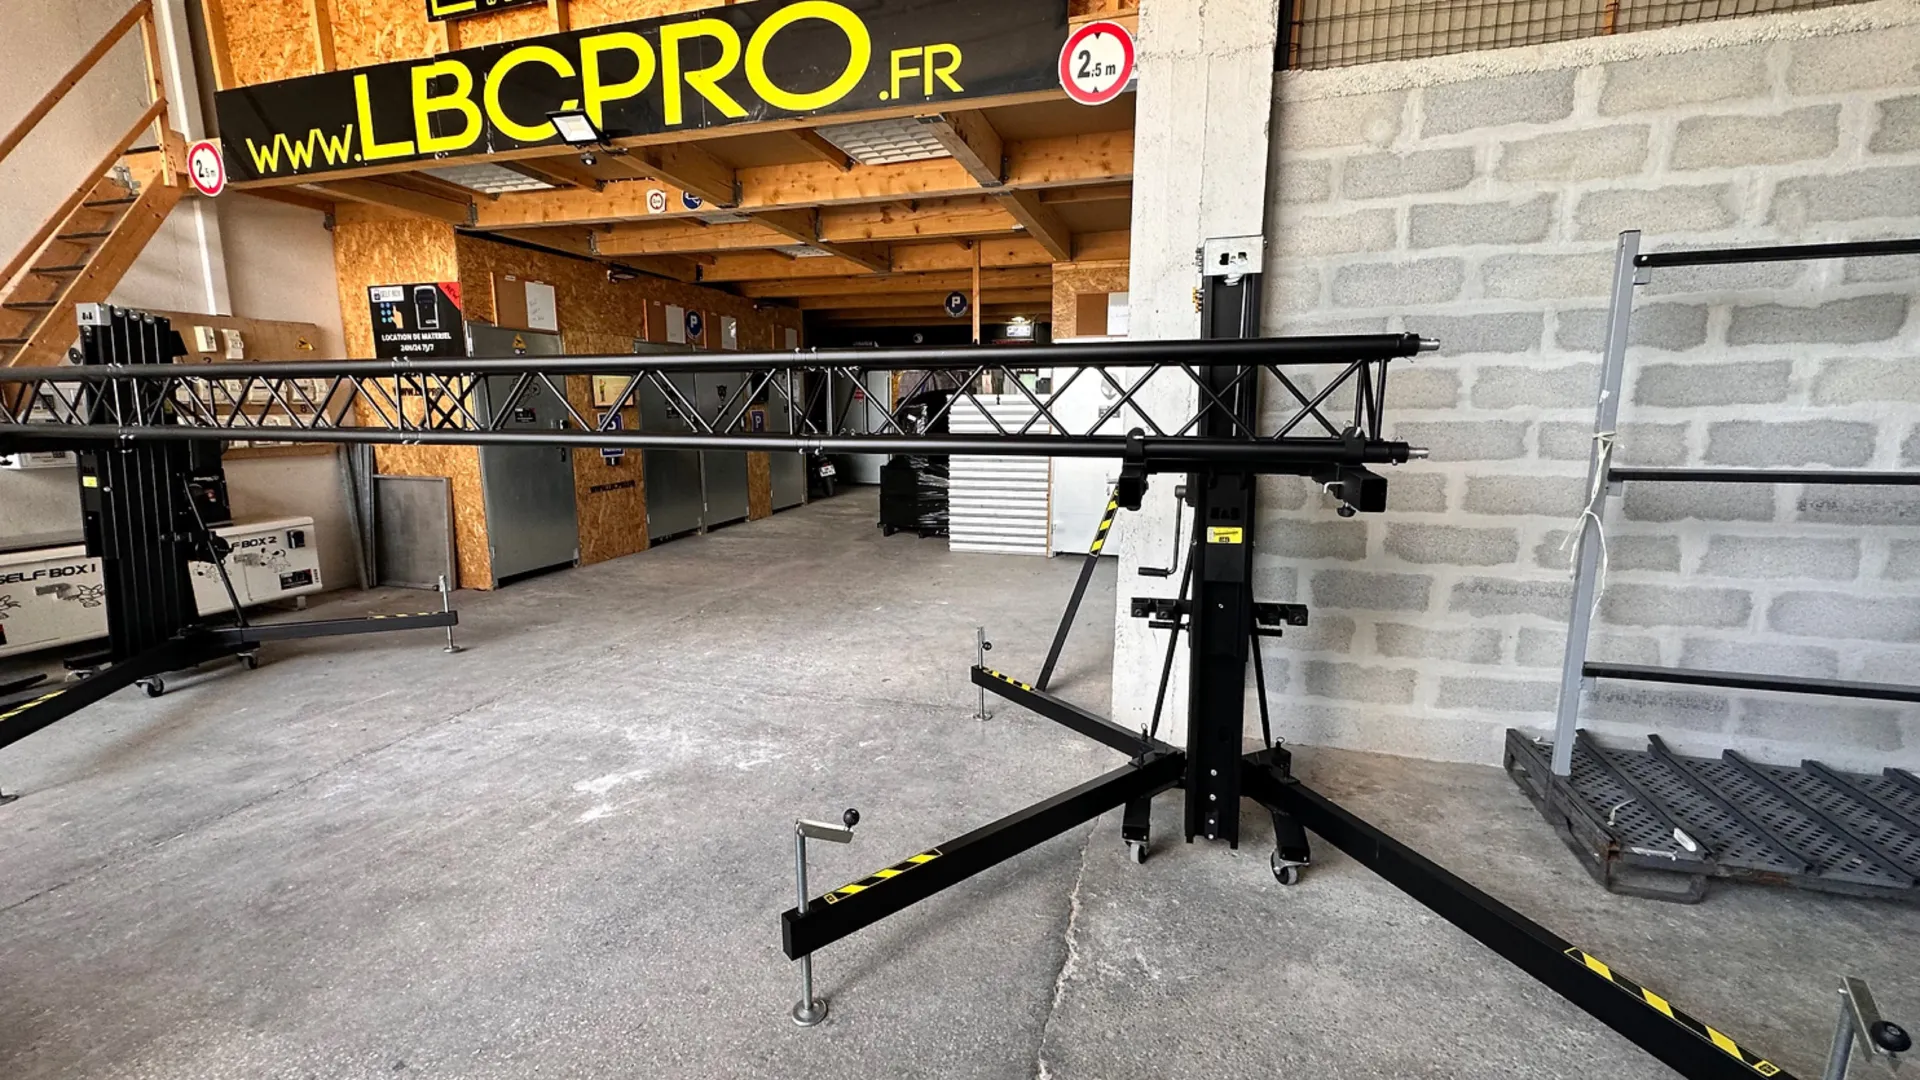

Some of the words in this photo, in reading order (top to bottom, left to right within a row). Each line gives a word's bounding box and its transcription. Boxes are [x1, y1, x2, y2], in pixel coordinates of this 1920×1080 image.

[1105, 63, 1116, 76] m
[690, 315, 698, 328] P
[381, 333, 412, 342] LOCATION
[413, 333, 421, 341] DE
[421, 332, 452, 340] MATERIEL
[241, 537, 266, 549] BOX
[268, 535, 277, 544] 2
[48, 563, 88, 578] BOX
